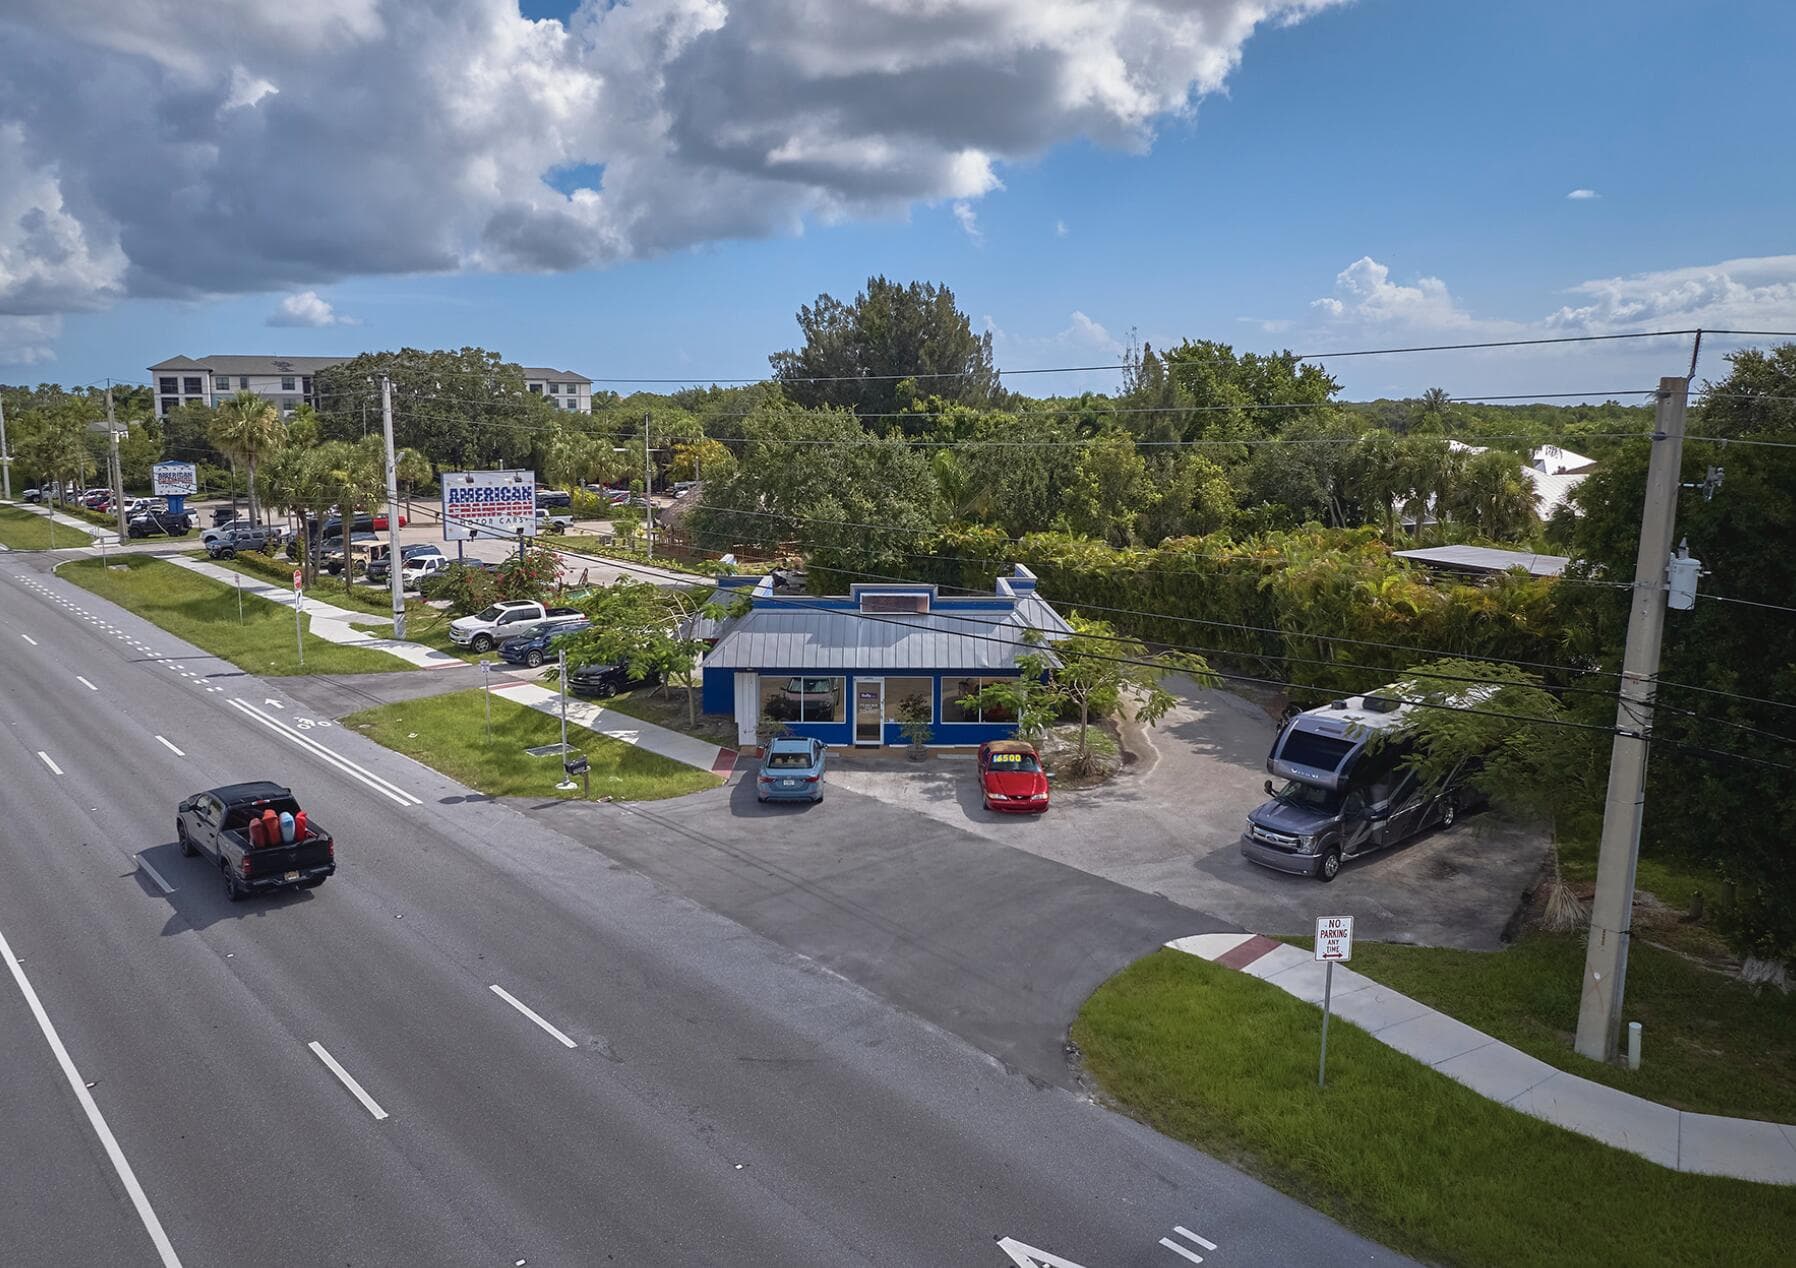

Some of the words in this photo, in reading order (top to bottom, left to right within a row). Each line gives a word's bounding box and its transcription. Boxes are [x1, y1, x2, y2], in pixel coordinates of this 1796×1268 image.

[449, 486, 532, 503] AMERICAN
[448, 501, 533, 518] CHAMPION
[460, 518, 493, 526] MOTOR
[499, 516, 524, 525] CARS
[1328, 919, 1341, 928] NO
[1320, 929, 1348, 938] PARKING
